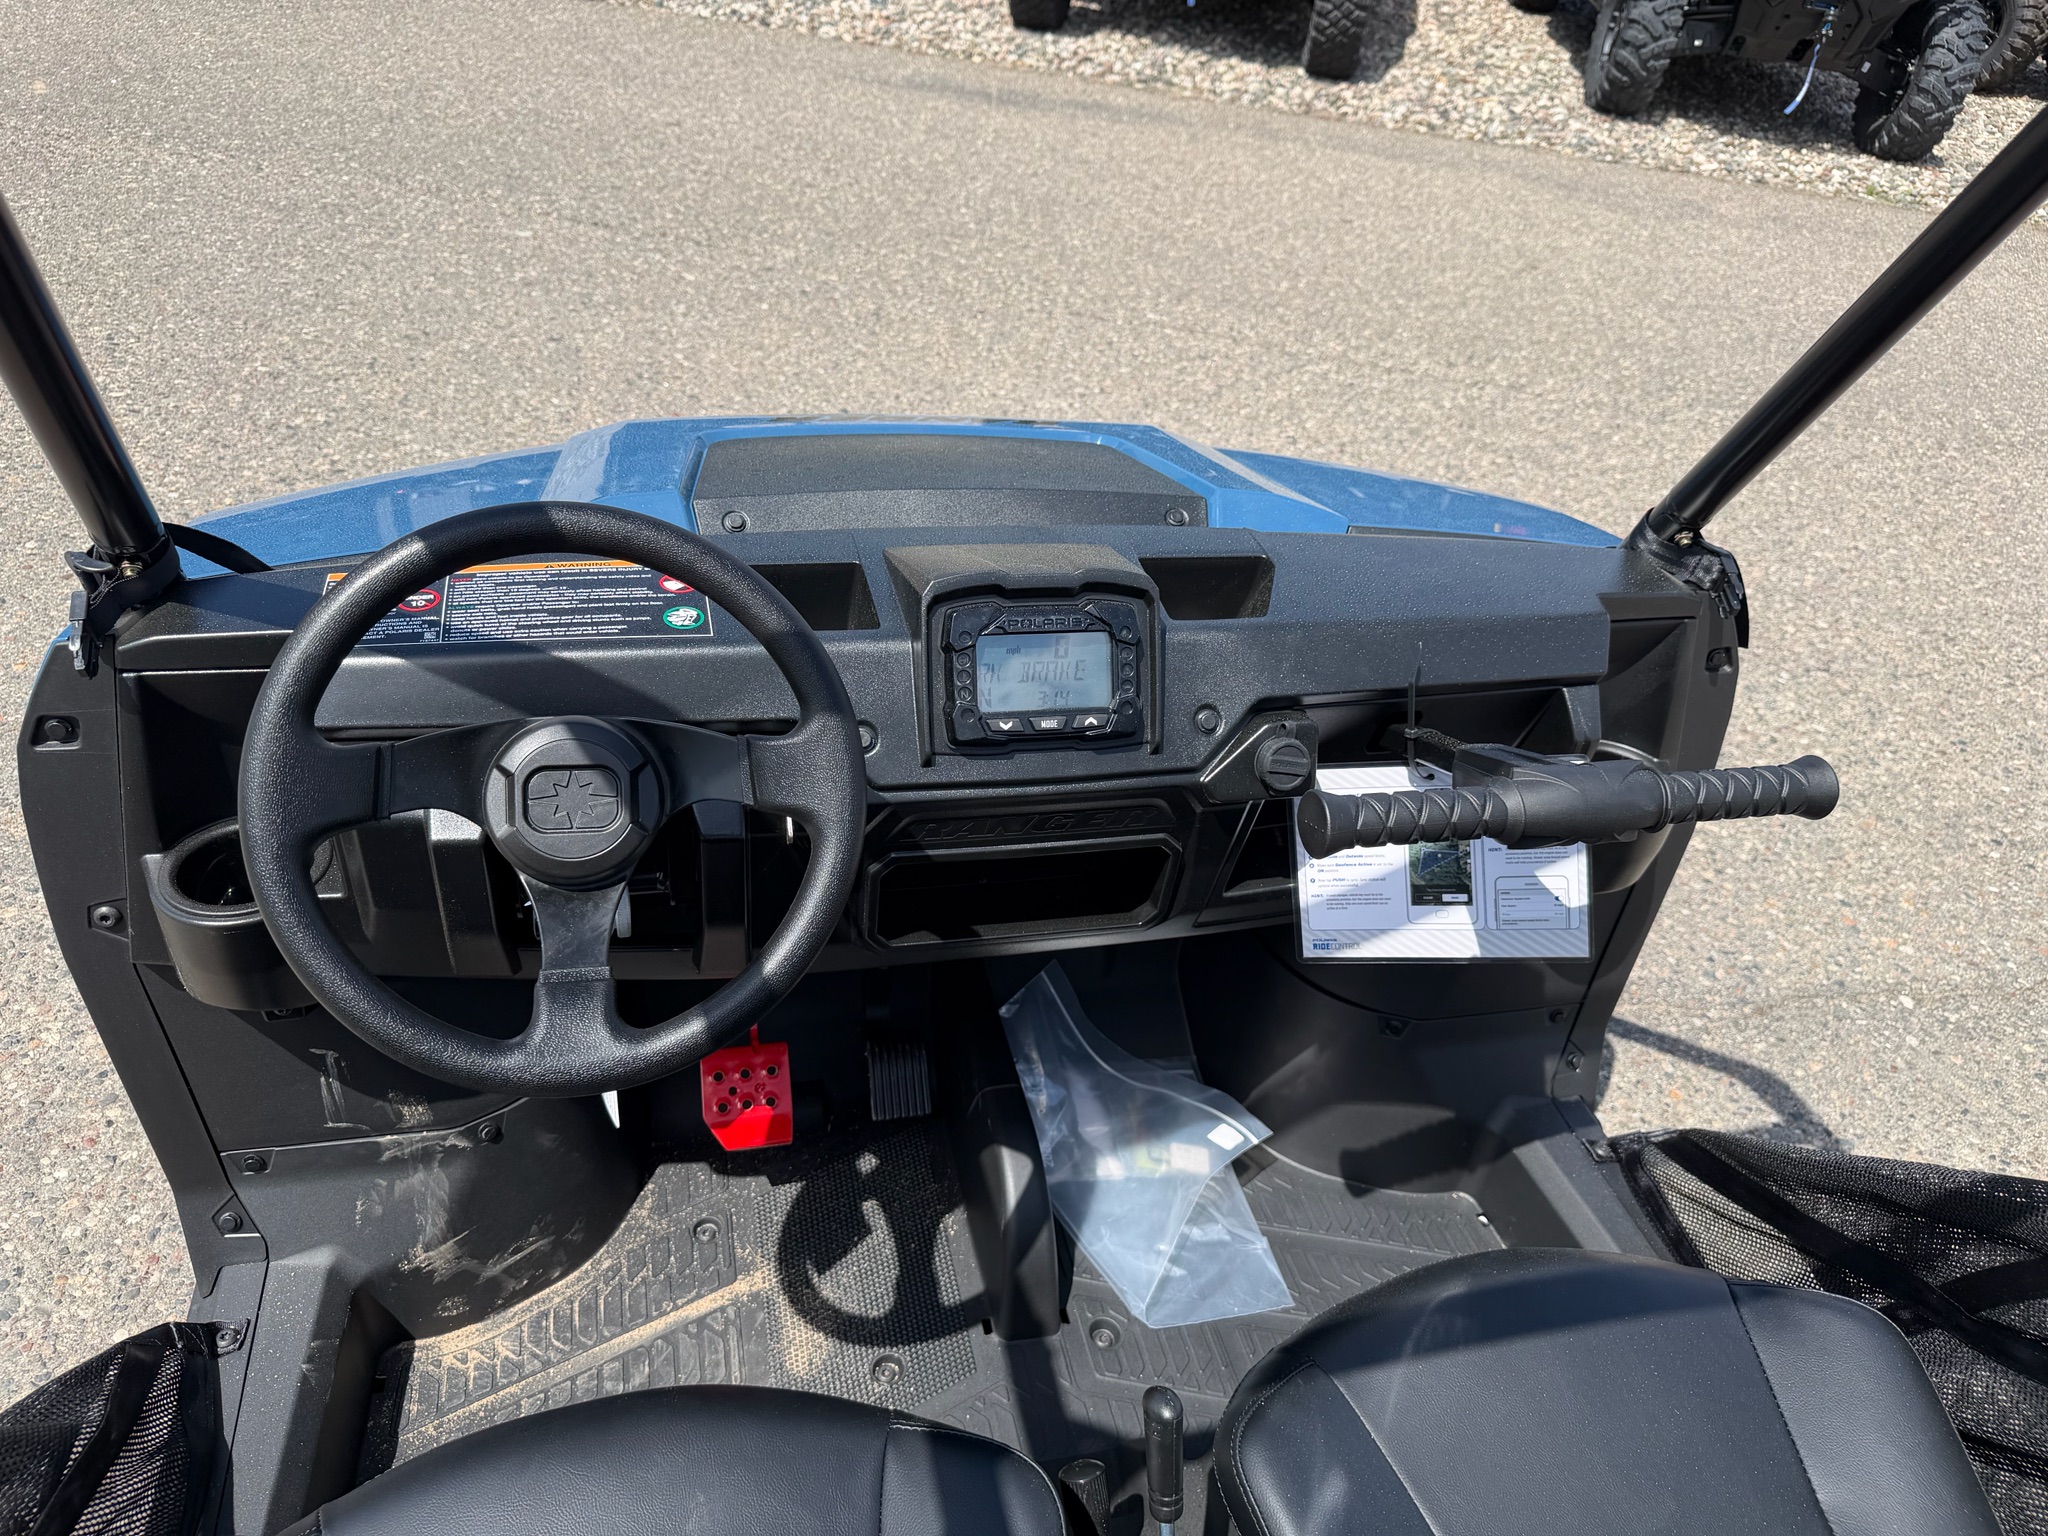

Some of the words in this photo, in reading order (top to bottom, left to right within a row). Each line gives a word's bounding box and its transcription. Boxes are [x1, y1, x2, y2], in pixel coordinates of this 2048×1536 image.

[1007, 617, 1083, 630] POLARIS
[1006, 645, 1021, 656] mph
[1054, 636, 1071, 659] 0
[1018, 659, 1086, 684] BRAKE
[1041, 720, 1058, 729] MODE
[902, 806, 1157, 840] RANGER
